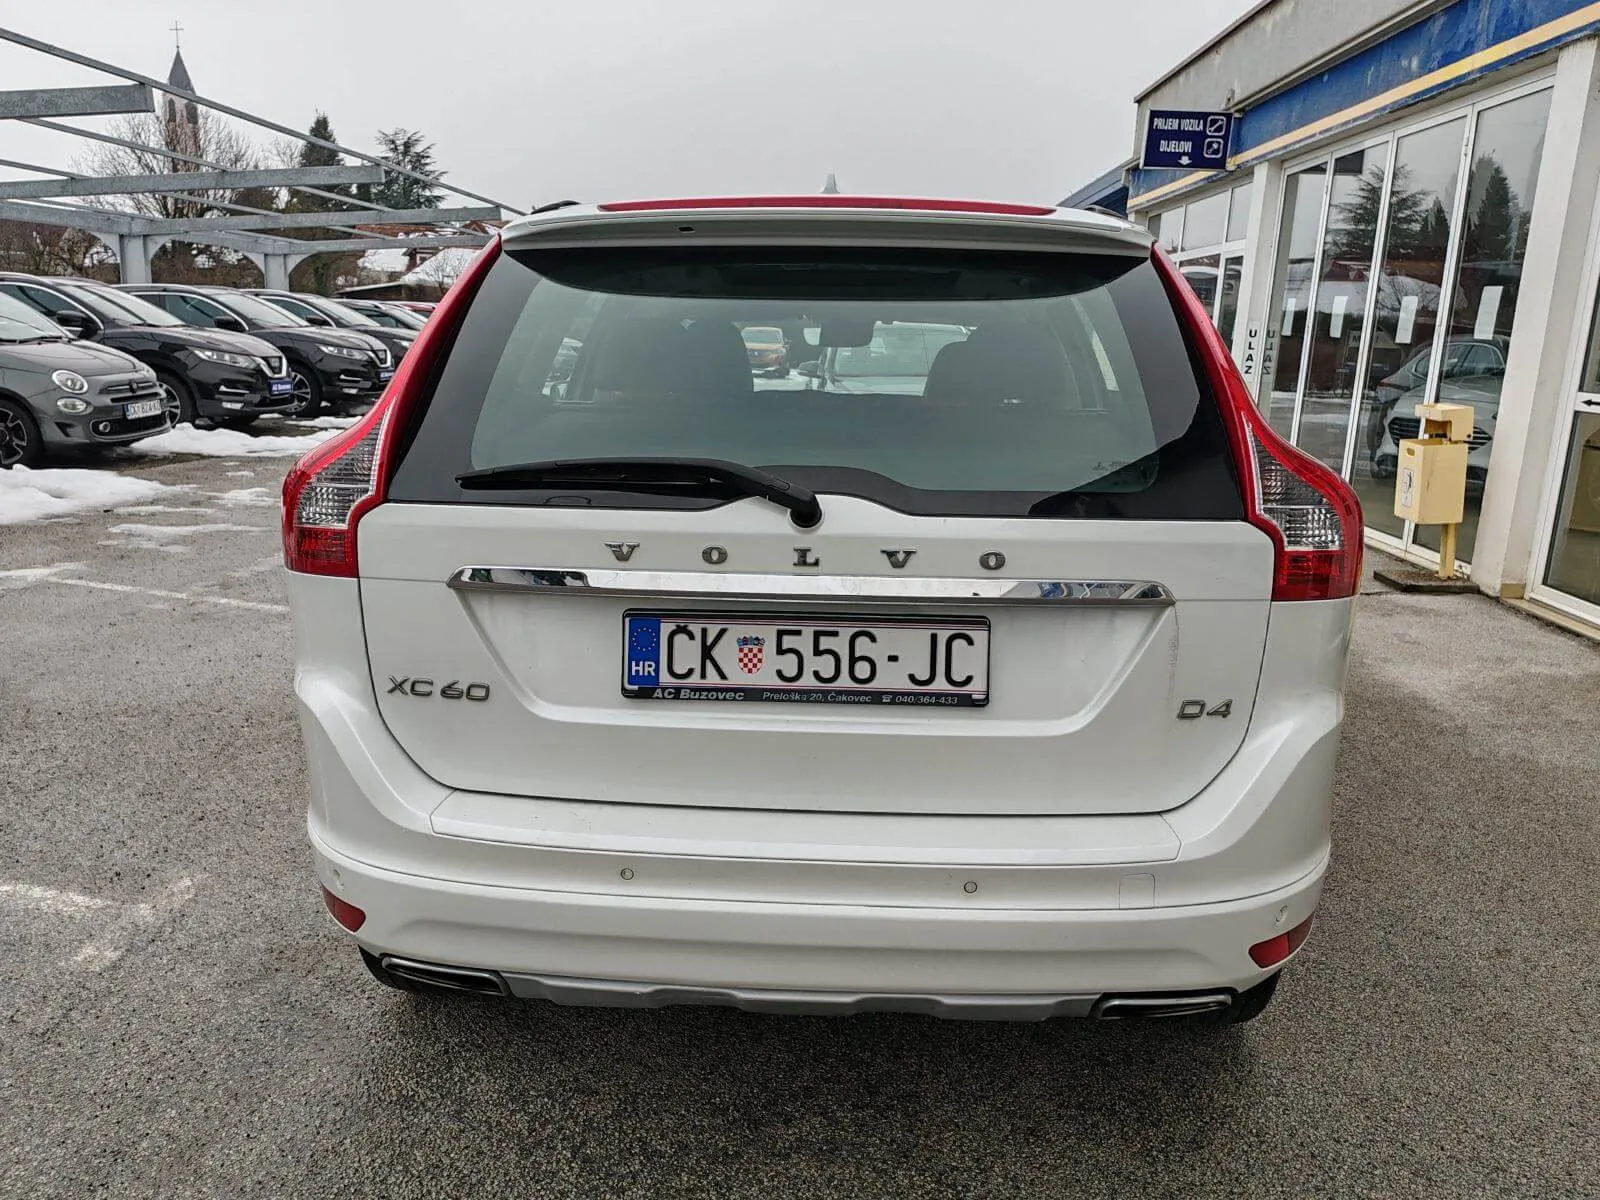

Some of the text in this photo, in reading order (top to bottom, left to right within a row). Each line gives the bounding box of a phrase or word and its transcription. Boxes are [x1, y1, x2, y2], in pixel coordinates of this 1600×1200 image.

[1153, 118, 1204, 131] PRIJEM VOZILA
[1159, 140, 1192, 153] DIJELOVI
[1244, 329, 1257, 374] ULAZ
[604, 541, 1006, 570] VOLVO
[666, 624, 728, 681] ČK
[631, 661, 655, 677] HR
[387, 676, 490, 701] XC60
[652, 688, 676, 700] AC
[679, 688, 745, 701] Buzovec
[1177, 699, 1233, 720] D4
